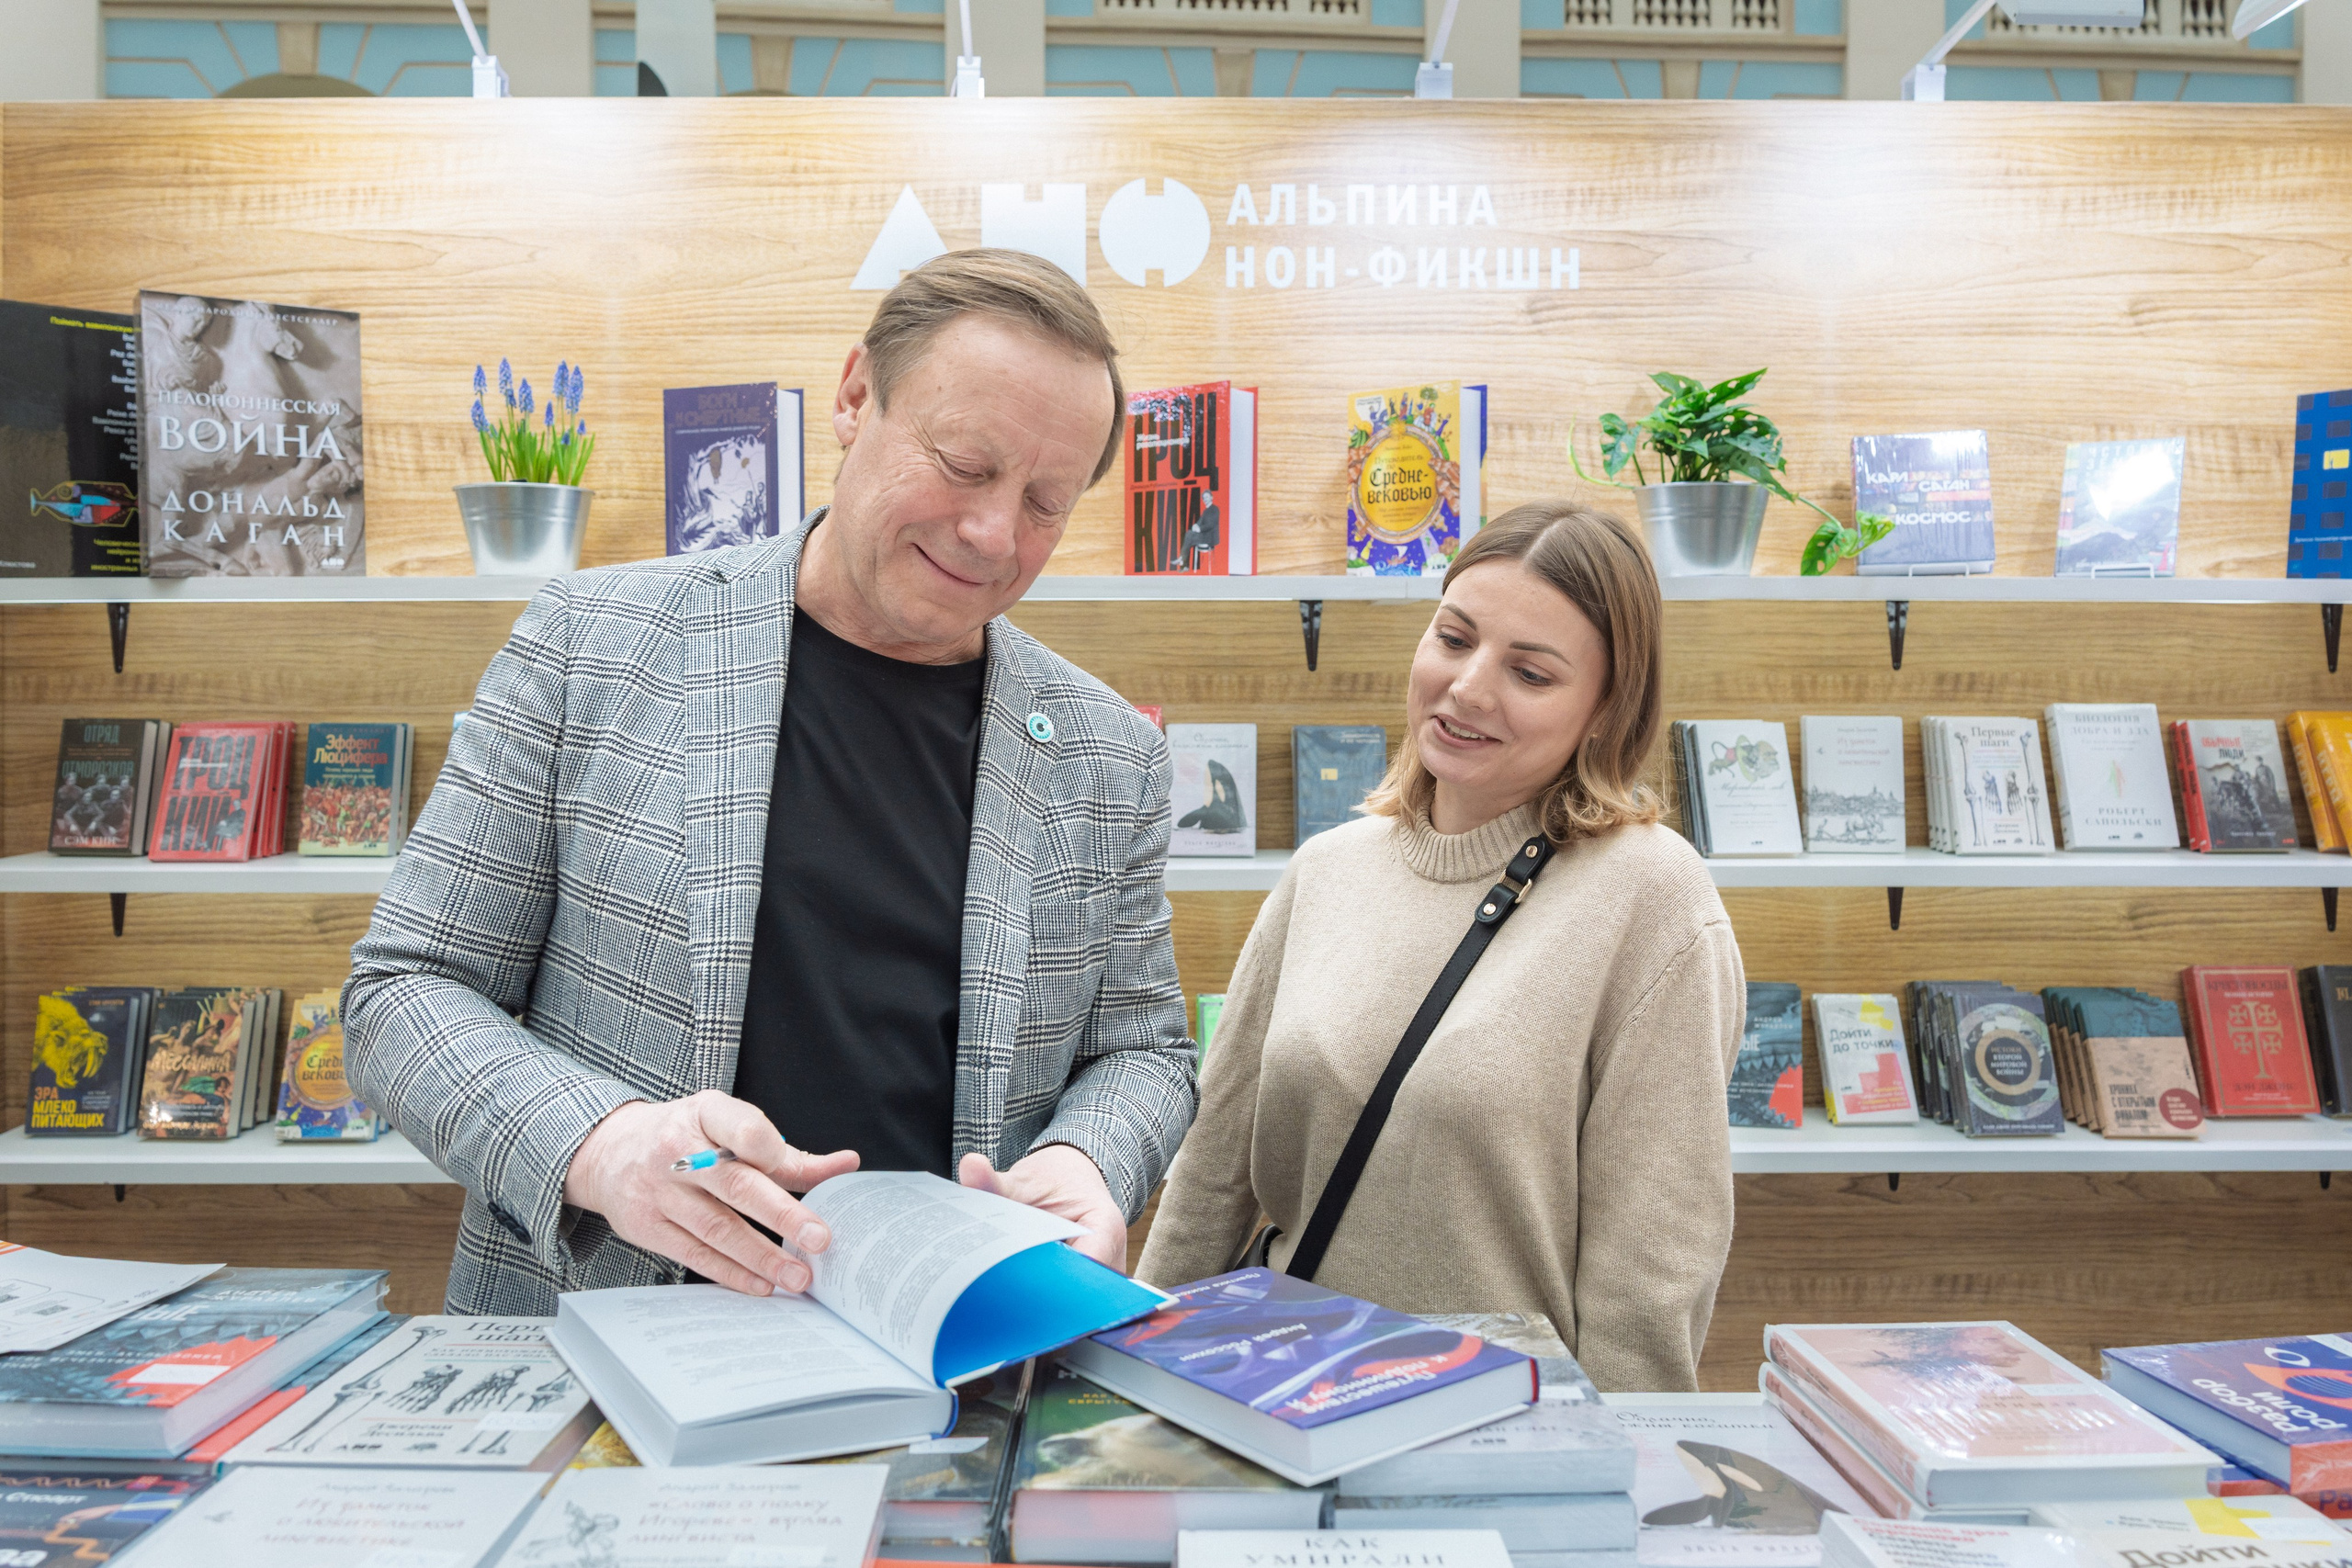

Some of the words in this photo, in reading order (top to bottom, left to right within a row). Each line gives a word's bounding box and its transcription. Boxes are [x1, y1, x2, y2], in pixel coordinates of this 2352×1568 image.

[1227, 183, 1498, 226] АЛЬПИНА
[1226, 244, 1581, 290] НОН-ФИКШН
[158, 389, 341, 416] ПЕЛОПОННЕССКАЯ
[159, 413, 346, 460] ВОЙНА
[1369, 467, 1429, 489] Средне-
[1865, 471, 1909, 485] КАРЛ
[1918, 479, 1971, 492] САГАН
[1367, 485, 1432, 504] вековью
[161, 489, 346, 520] ДОНАЛЬД
[1895, 511, 1972, 525] КОСМОС
[164, 519, 345, 547] КАГАН
[84, 725, 120, 744] ОТРЯД
[325, 734, 380, 751] Эффект
[1971, 727, 2017, 740] Первые
[1980, 738, 2010, 748] шаги
[313, 747, 388, 768] Люцифера
[2219, 748, 2246, 760] ЛЮДИ
[1829, 1028, 1872, 1043] Дойти
[1833, 1043, 1850, 1054] до
[1853, 1039, 1894, 1051] точки
[33, 1086, 59, 1100] ЭРА
[32, 1100, 77, 1114] МЛЕКО
[31, 1113, 106, 1129] ПИТАЮЩИХ
[1255, 1323, 1308, 1343] Андрей
[1179, 1339, 1251, 1363] Россохин
[1301, 1370, 1438, 1415] Путешествие
[2191, 1378, 2312, 1433] Разбор
[1304, 1537, 1380, 1550] КАК
[1244, 1553, 1447, 1567] УМИРАЛИ
